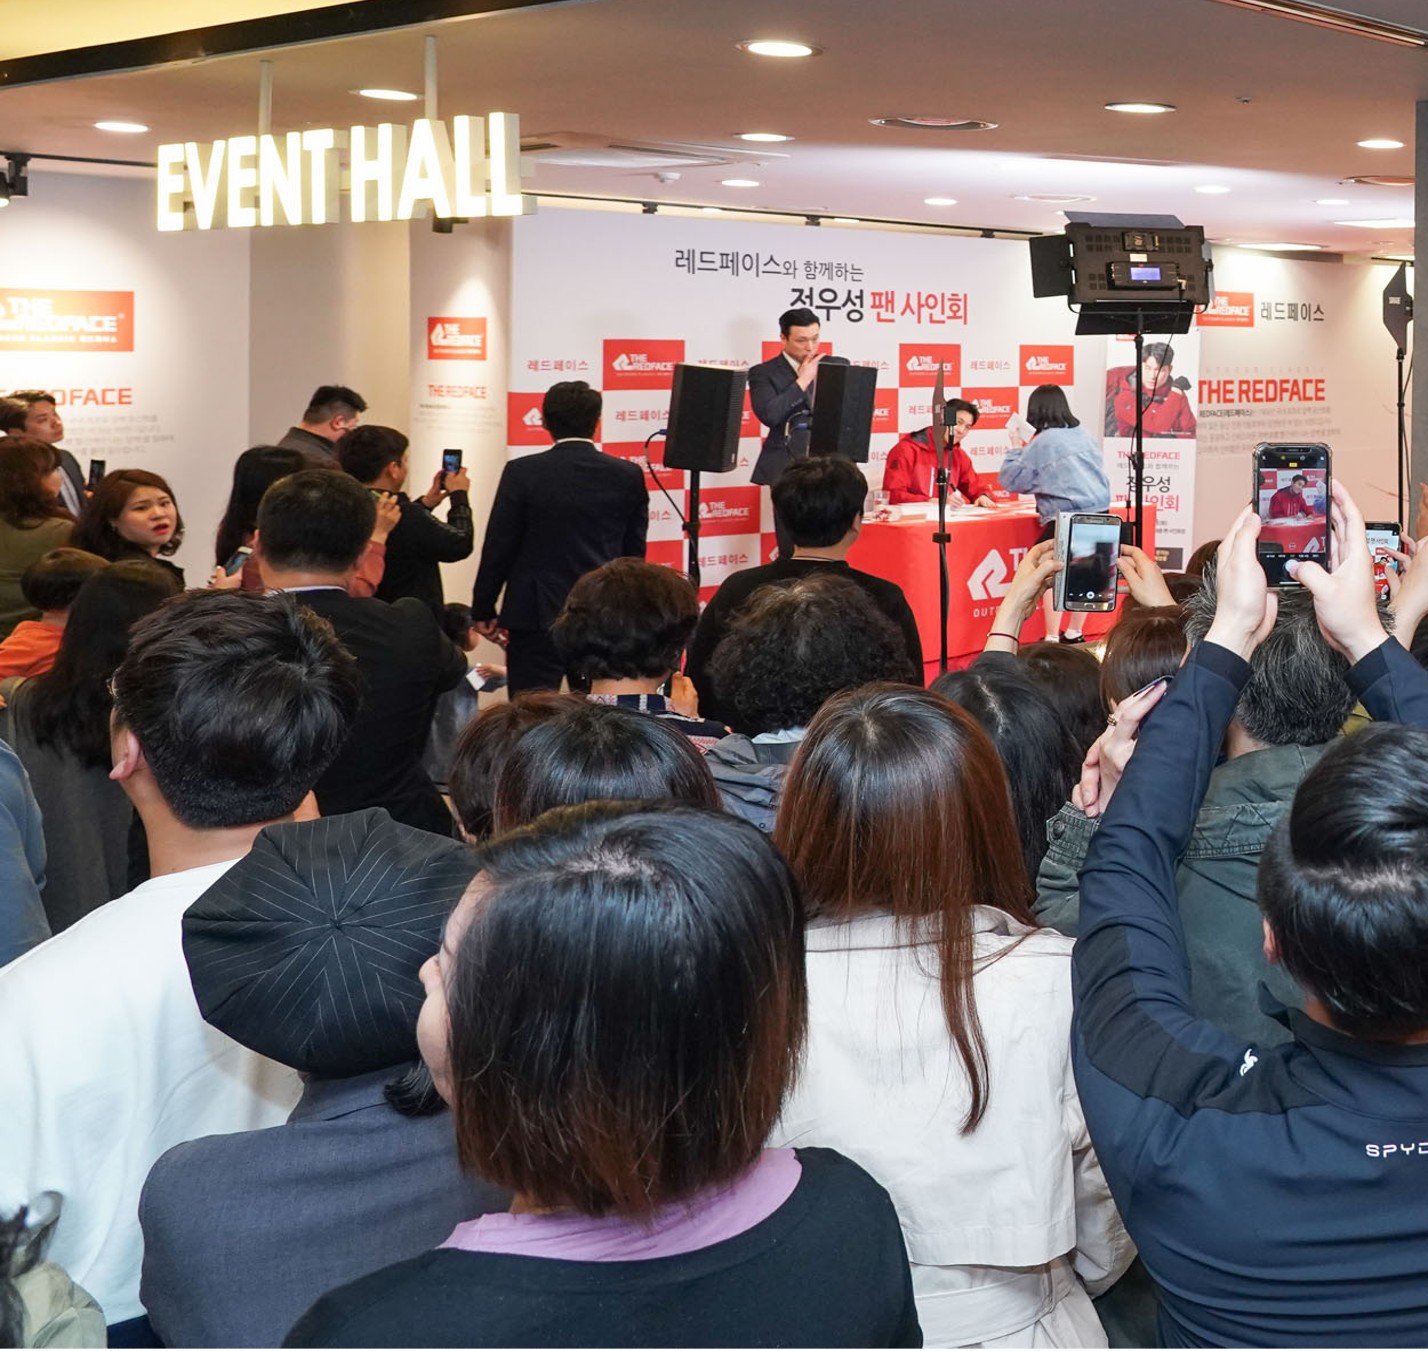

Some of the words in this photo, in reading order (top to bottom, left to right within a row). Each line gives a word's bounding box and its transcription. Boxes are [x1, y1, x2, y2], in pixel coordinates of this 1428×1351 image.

[157, 127, 341, 232] EVENT
[350, 111, 524, 223] HALL
[675, 249, 797, 279] 레드페이스와
[804, 261, 864, 281] 함께하는
[790, 286, 864, 323] 정우성
[870, 291, 896, 323] 팬
[901, 292, 968, 325] 사인회
[1261, 302, 1324, 322] 레드페이스
[630, 353, 648, 363] THE
[919, 356, 932, 364] THE
[1036, 356, 1049, 364] THE
[527, 360, 590, 371] 레드페이스
[632, 362, 674, 371] REDFACE
[970, 360, 1011, 370] 레드페이스
[1199, 379, 1235, 403] THE
[1238, 378, 1326, 402] REDFACE
[615, 410, 669, 422] 레드페이스
[970, 446, 1009, 456] 레드페이스
[1143, 451, 1180, 460] EDFACE
[709, 502, 726, 511] THE
